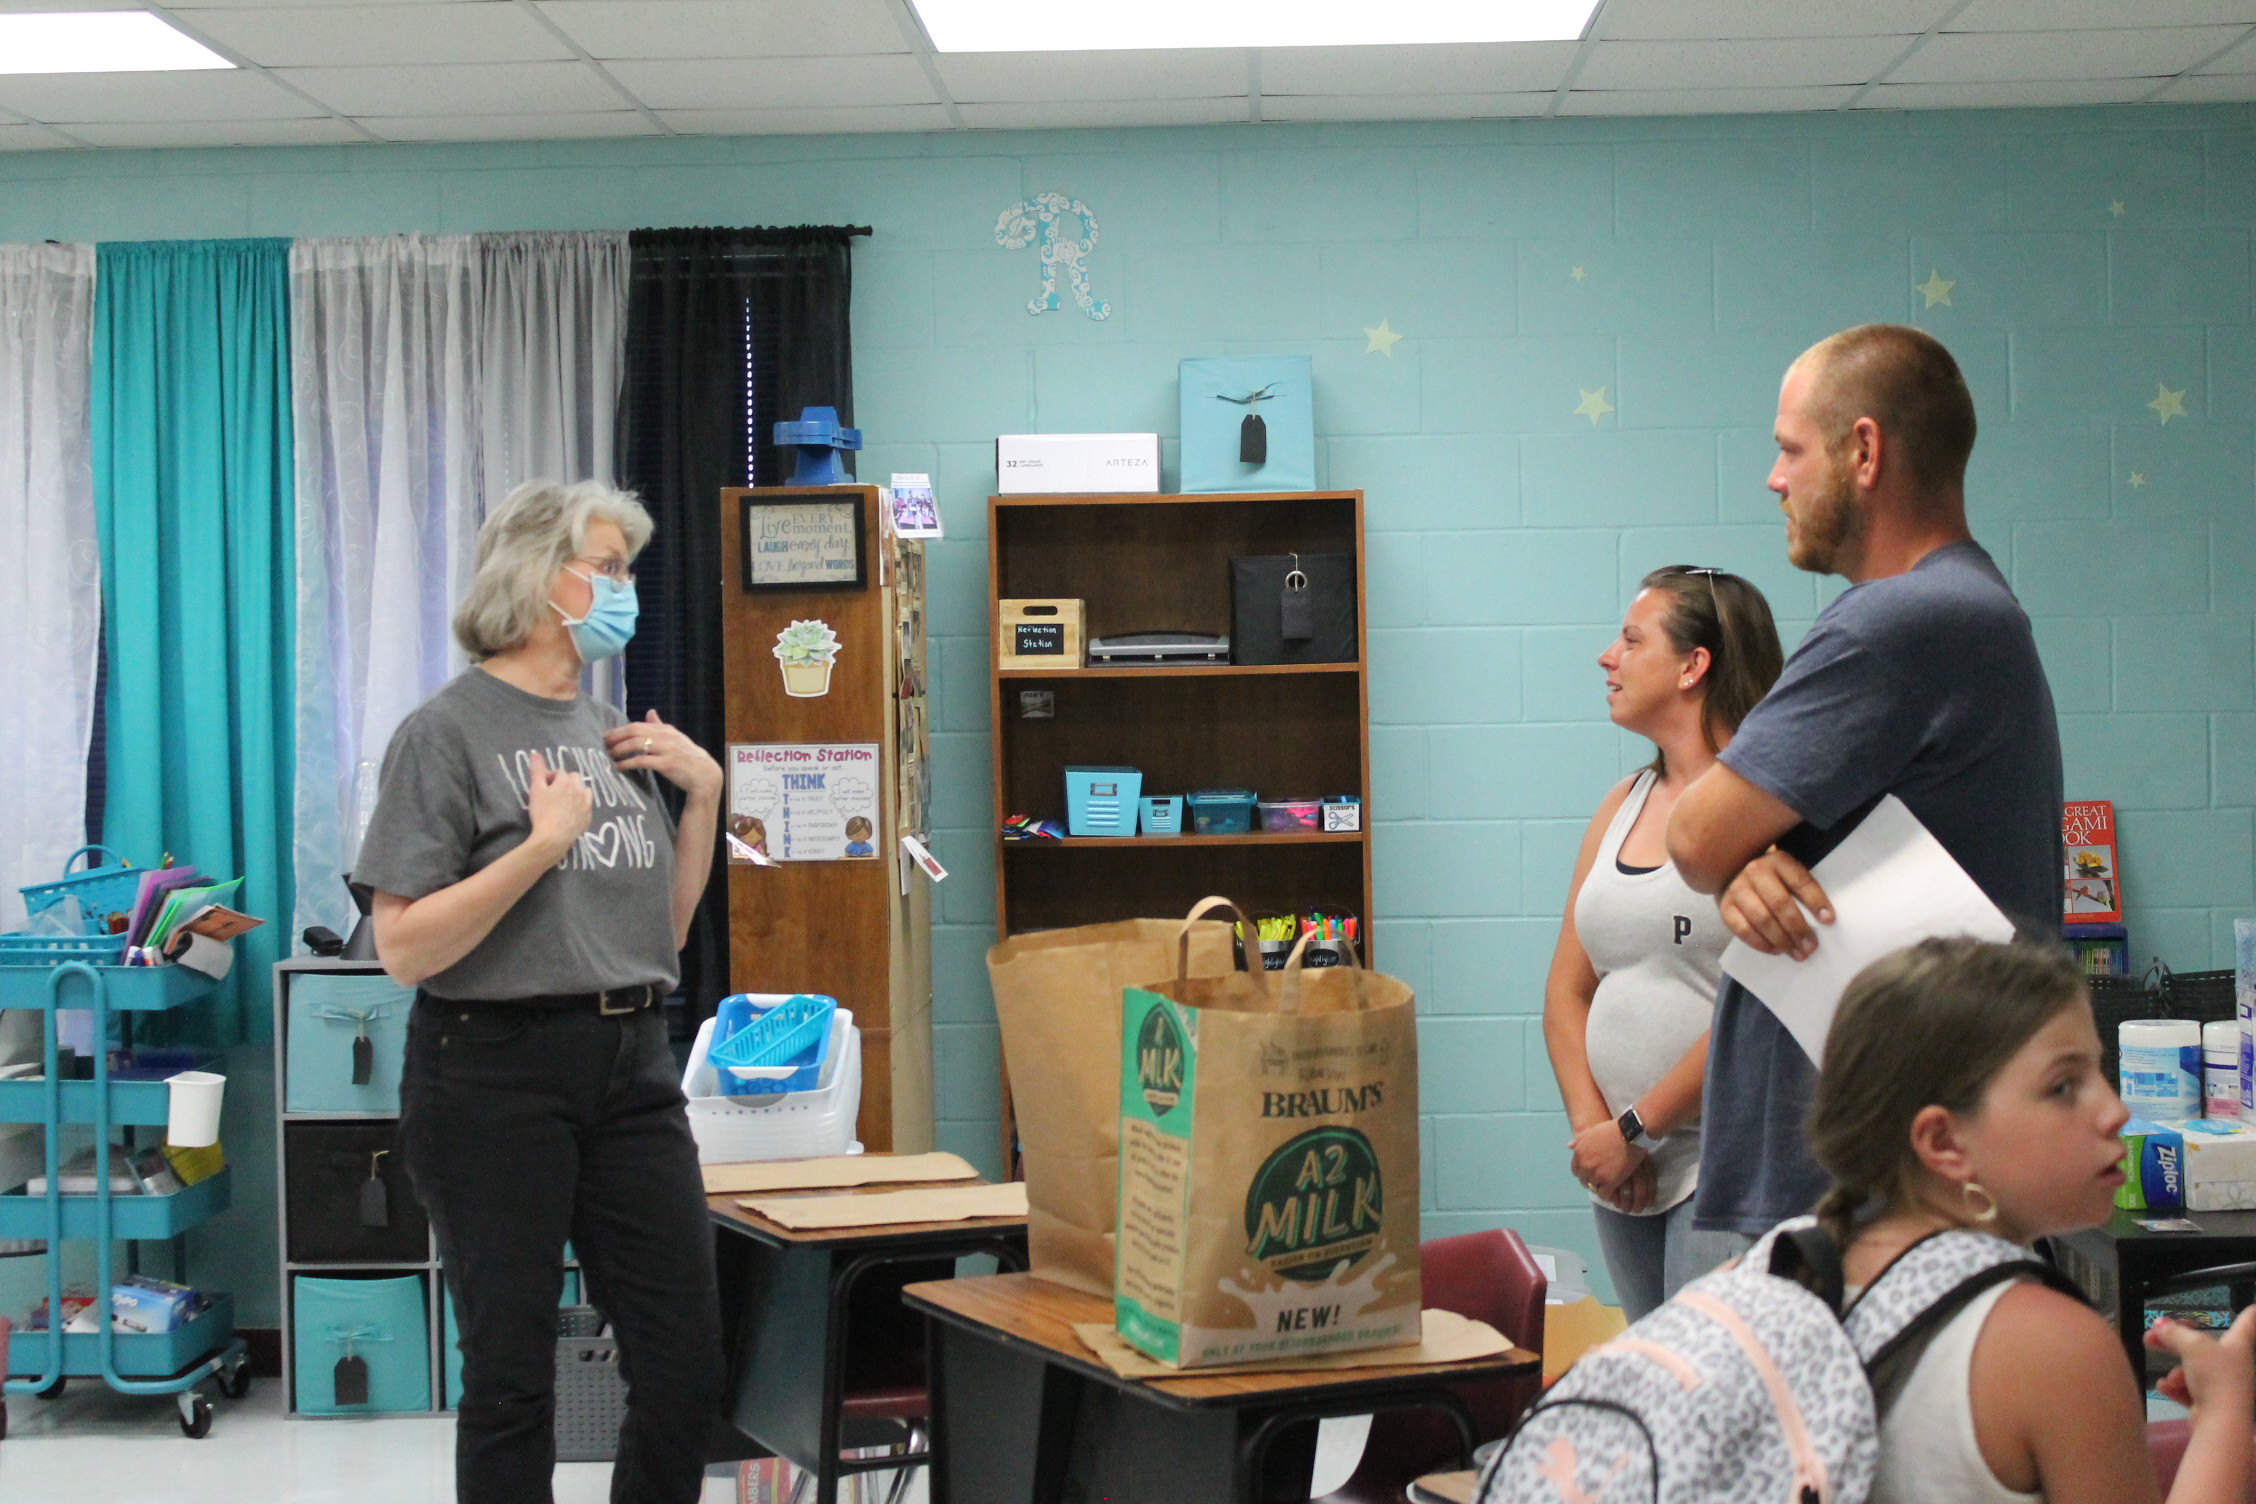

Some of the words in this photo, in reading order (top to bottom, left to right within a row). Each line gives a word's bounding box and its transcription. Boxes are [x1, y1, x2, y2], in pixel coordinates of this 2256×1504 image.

[1006, 460, 1017, 468] 32
[1105, 458, 1149, 467] ARTEZA
[757, 541, 789, 552] LAUGH
[825, 559, 855, 570] WORDS
[1017, 625, 1057, 634] Reflection
[1023, 639, 1053, 649] Station
[737, 750, 811, 763] Reflection
[816, 749, 872, 762] Station
[782, 773, 826, 790] THINK
[2064, 805, 2107, 817] GREAT
[2062, 815, 2108, 831] GAMI
[2062, 830, 2092, 846] OK
[1673, 915, 1692, 945] P
[1261, 1080, 1383, 1118] BRAUM'S
[1294, 1144, 1348, 1191] A2
[2156, 1145, 2179, 1193] Ziploc
[1246, 1170, 1381, 1258] MILK
[1276, 1304, 1341, 1333] NEW!
